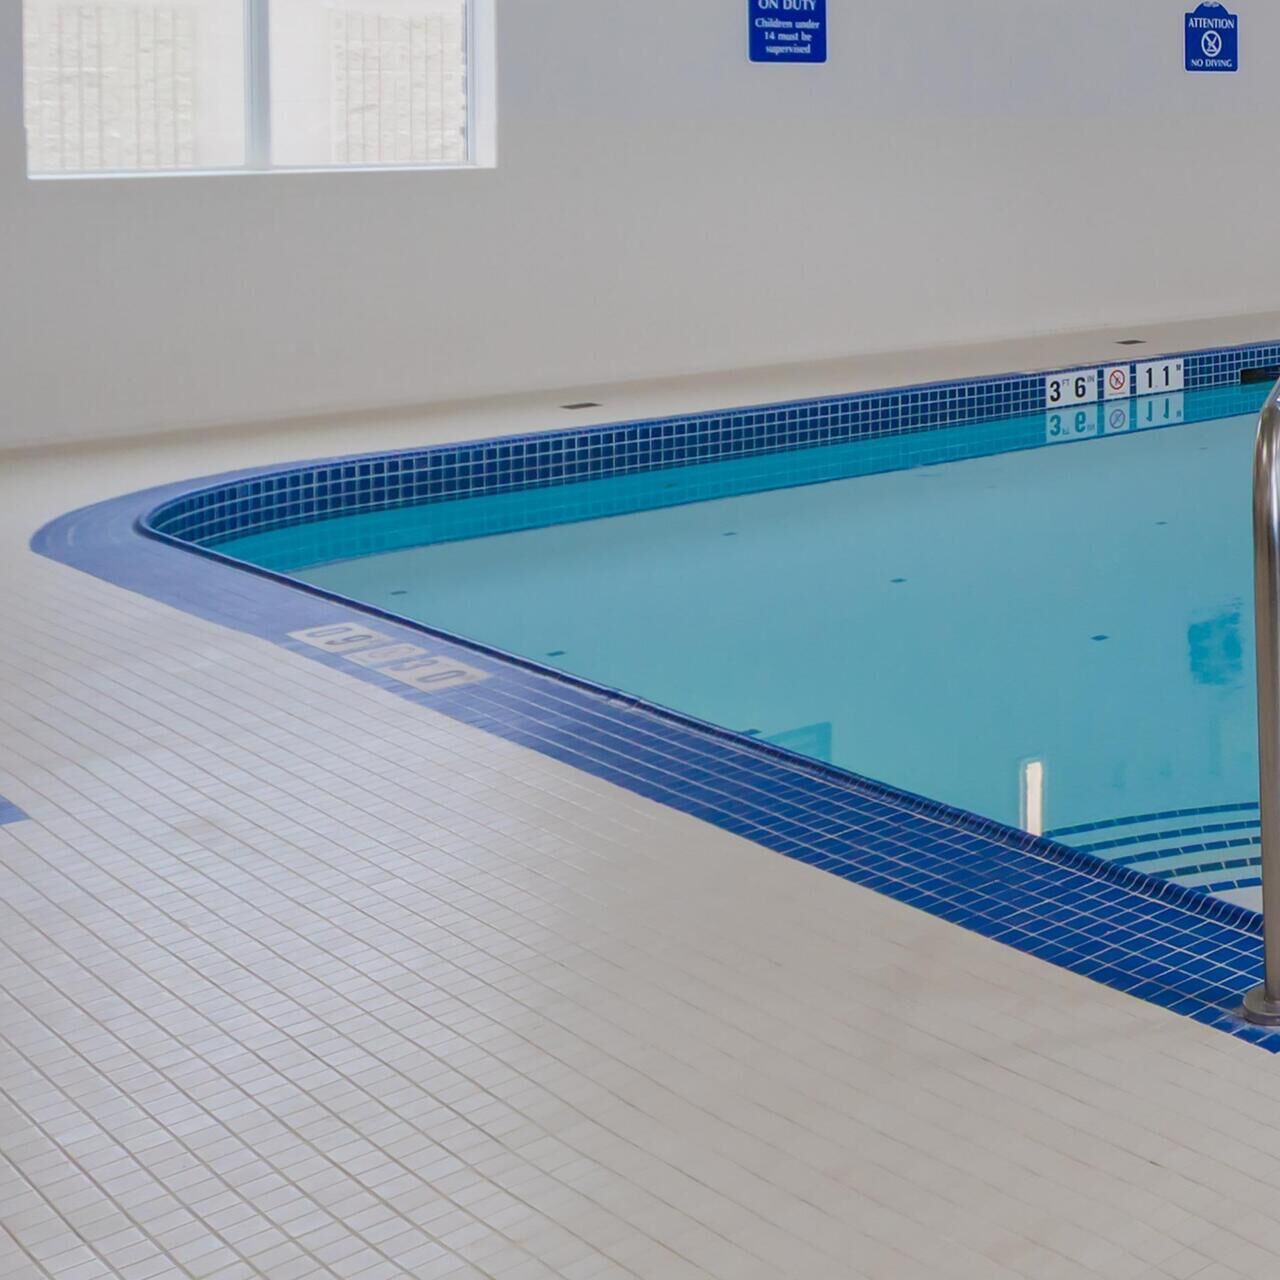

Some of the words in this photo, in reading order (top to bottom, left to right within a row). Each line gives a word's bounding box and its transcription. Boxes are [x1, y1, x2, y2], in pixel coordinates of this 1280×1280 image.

[755, 17, 793, 28] Children
[795, 19, 820, 29] under
[1188, 17, 1235, 29] ATTENTION
[764, 31, 775, 40] 14
[778, 32, 799, 41] must
[801, 31, 812, 41] be
[765, 44, 811, 55] supervised
[1191, 59, 1203, 67] NO
[1205, 59, 1232, 68] DIVING
